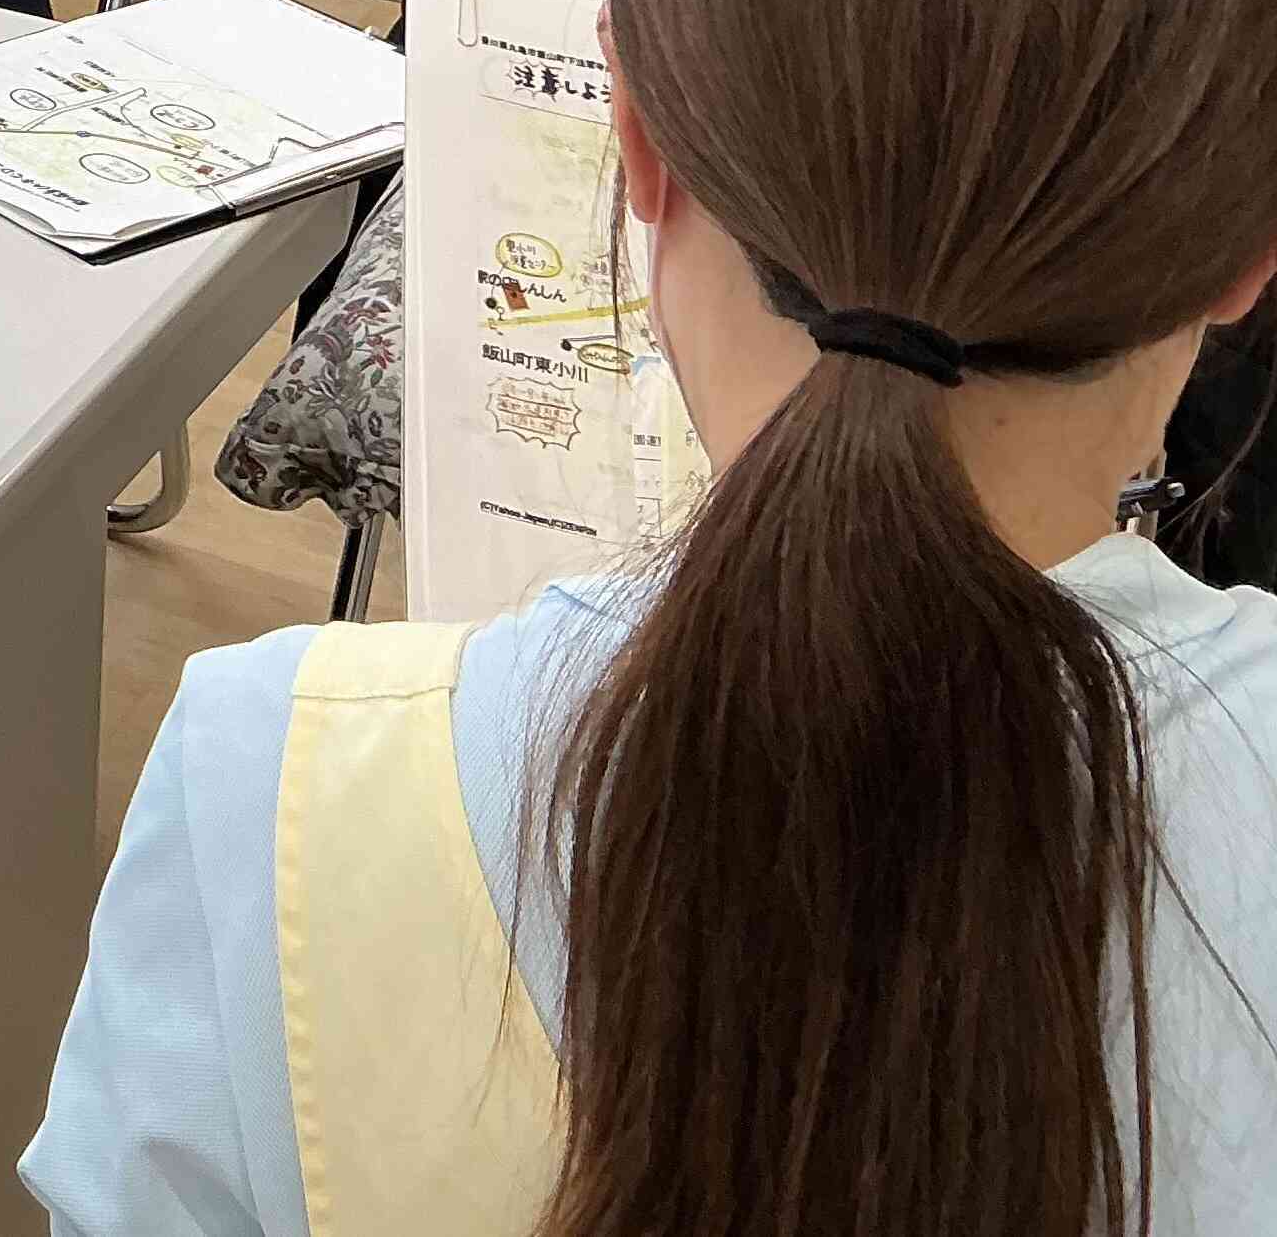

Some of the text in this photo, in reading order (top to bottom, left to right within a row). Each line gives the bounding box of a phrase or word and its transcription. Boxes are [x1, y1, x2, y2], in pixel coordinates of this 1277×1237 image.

[482, 343, 589, 383] 飯山町東小川
